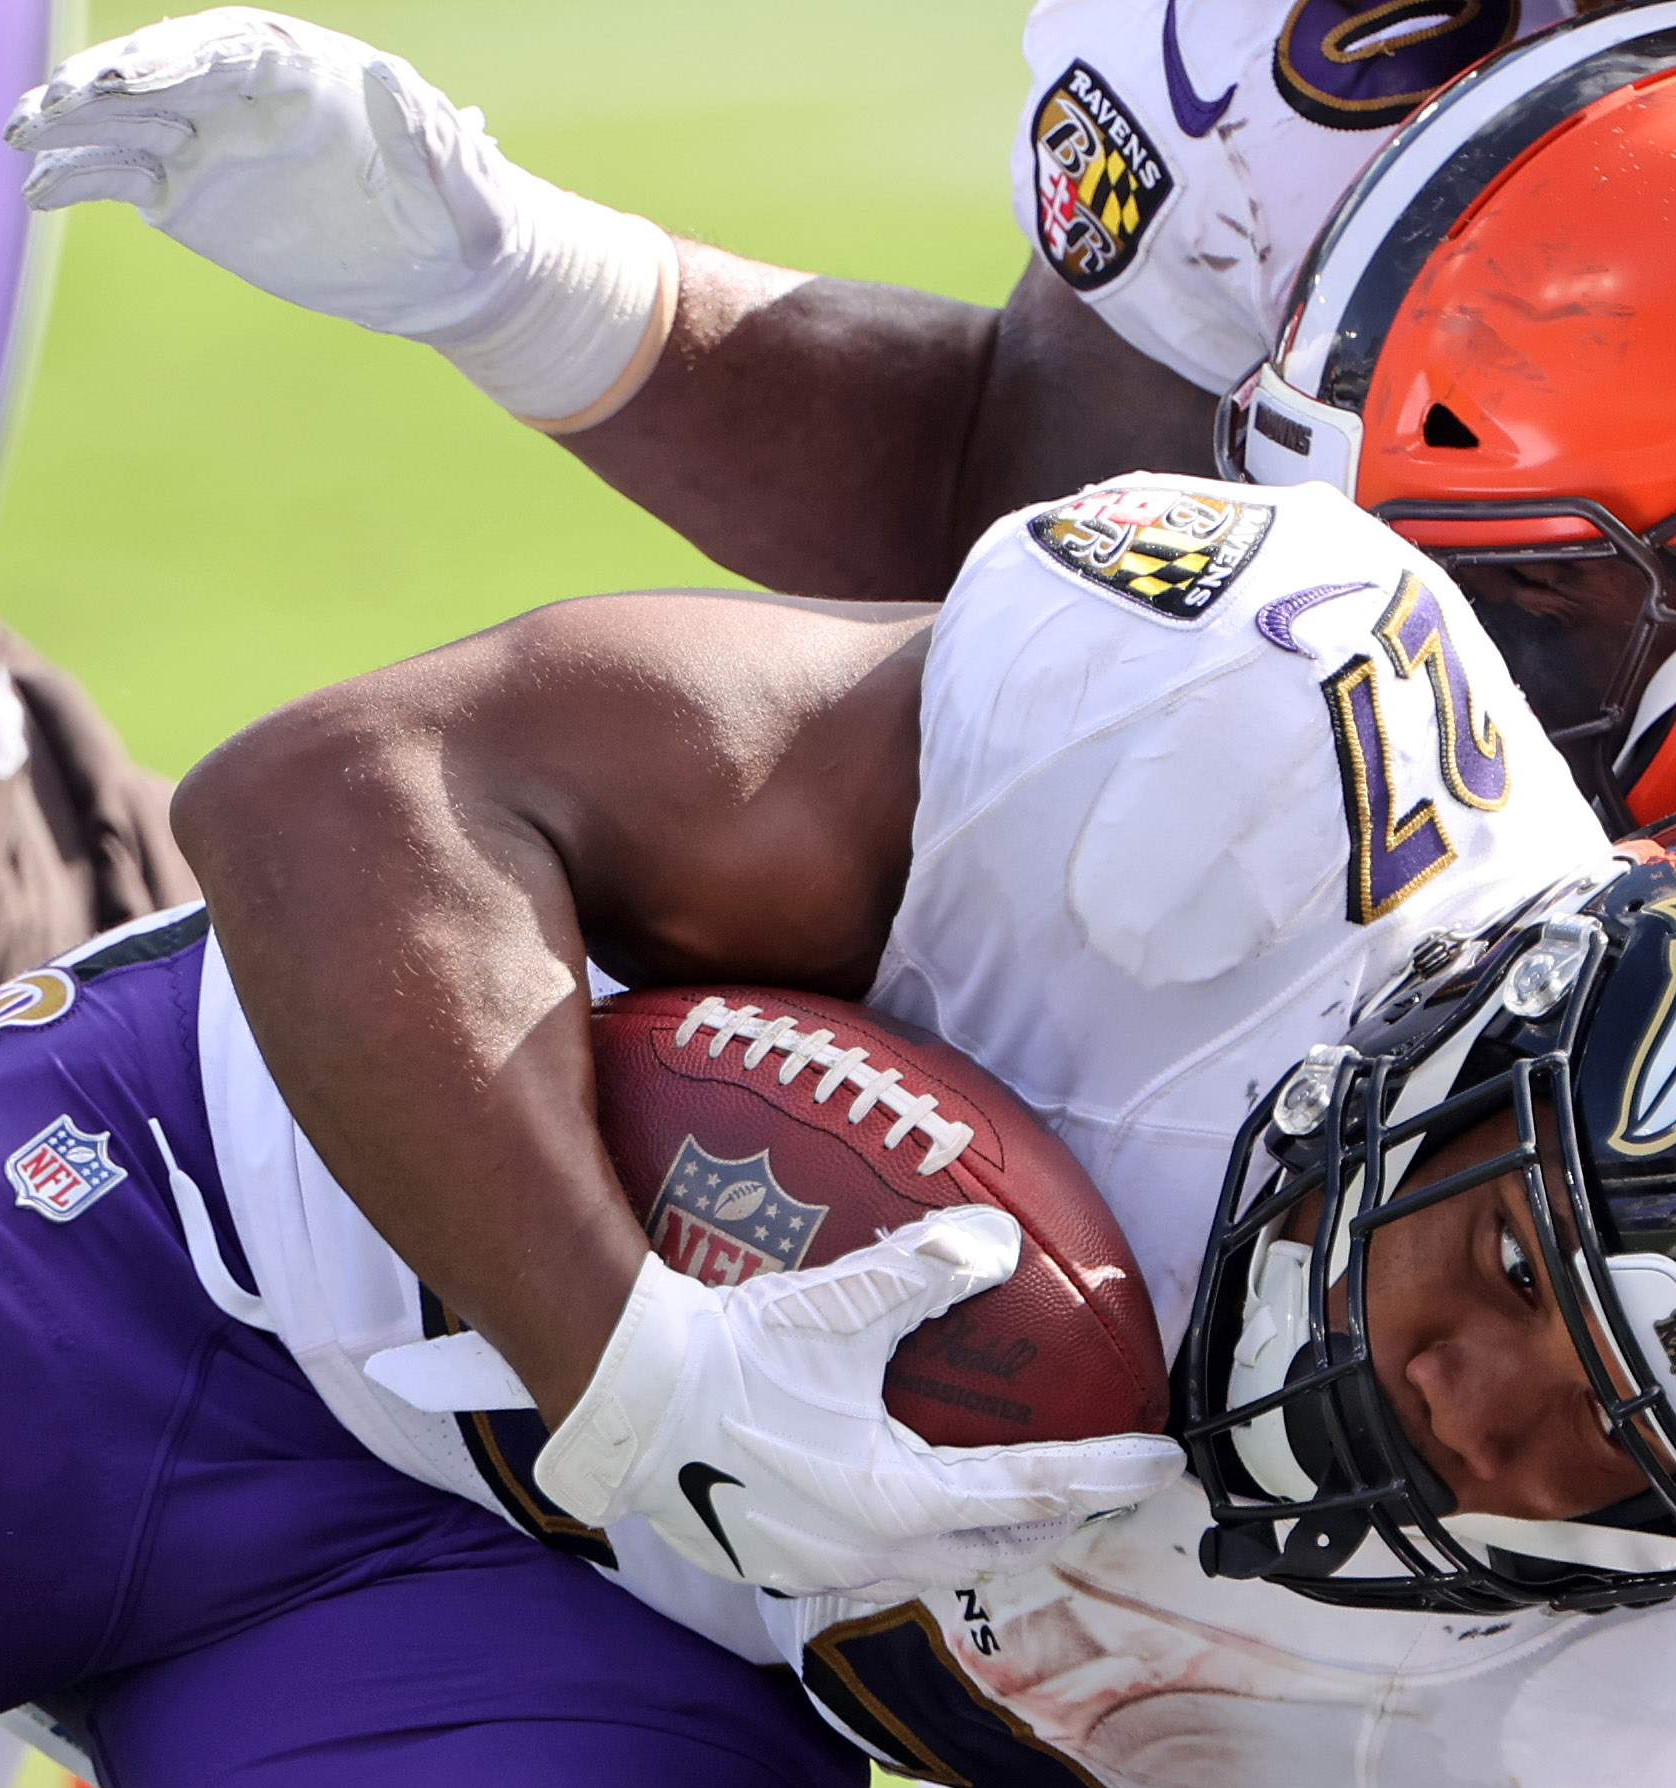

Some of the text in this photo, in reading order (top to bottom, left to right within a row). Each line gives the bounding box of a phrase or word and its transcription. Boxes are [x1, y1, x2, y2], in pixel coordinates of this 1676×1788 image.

[1068, 68, 1162, 191] RAVENS
[1320, 569, 1511, 925] 27
[20, 1146, 83, 1208] NFL
